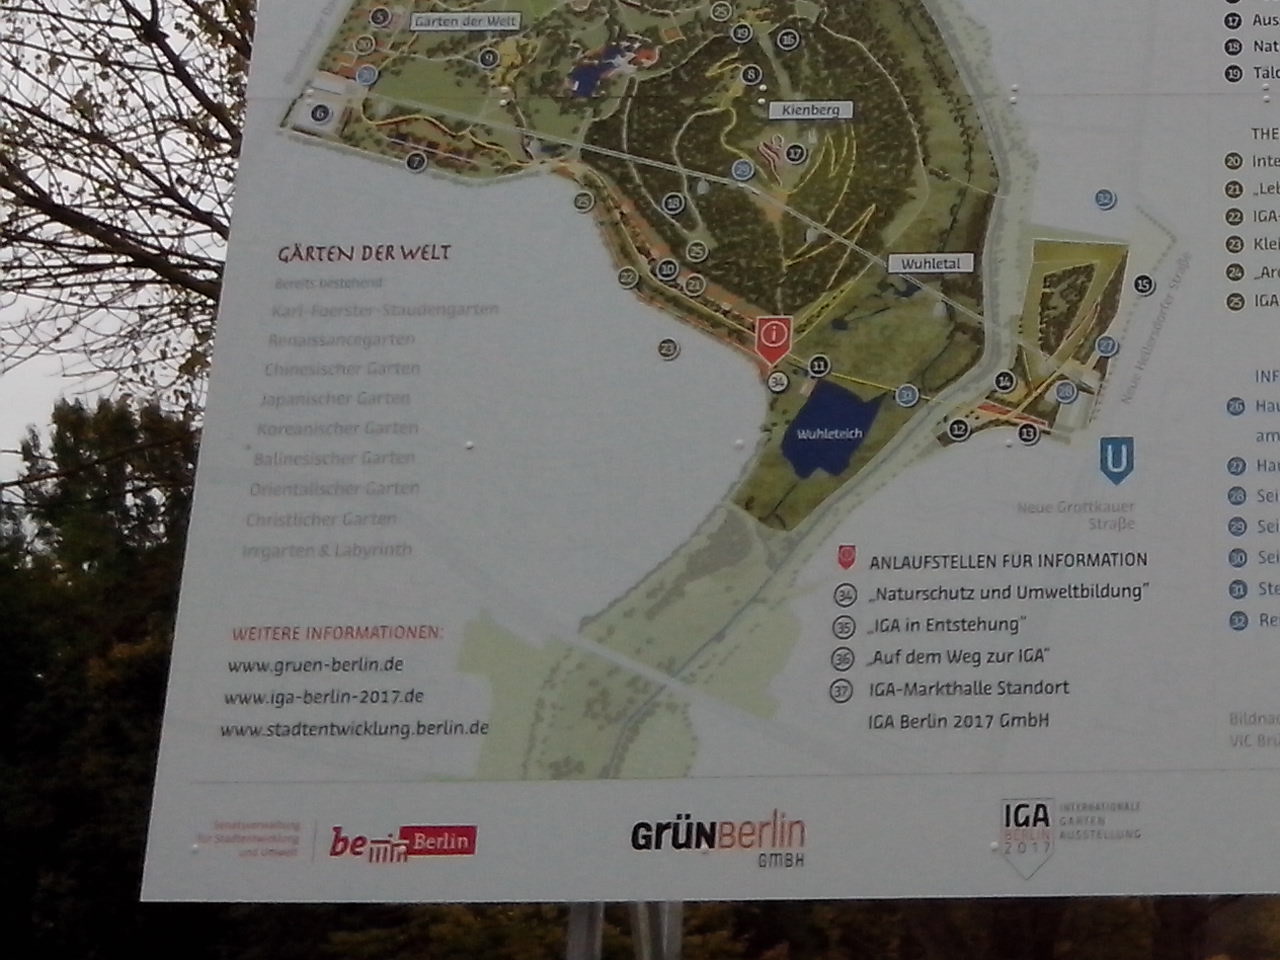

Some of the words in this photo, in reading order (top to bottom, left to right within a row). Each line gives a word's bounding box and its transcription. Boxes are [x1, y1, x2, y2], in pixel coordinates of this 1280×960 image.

[781, 103, 842, 119] Kienberg
[277, 242, 355, 264] GÄRTEN
[361, 244, 396, 262] DER
[399, 243, 452, 262] WELT
[900, 256, 961, 270] Wuhletal
[796, 427, 863, 441] Wuhleteich
[1255, 431, 1280, 443] am
[1106, 444, 1129, 473] U
[868, 553, 997, 571] ANLAUFSTELLEN
[1037, 551, 1148, 569] INFORMATION
[979, 584, 1012, 600] und
[232, 625, 301, 642] WEITERE
[905, 617, 921, 633] in
[227, 655, 404, 677] www.gruen-berlin.de
[905, 648, 942, 665] dem
[946, 649, 982, 669] Weg
[986, 651, 1015, 664] zur
[869, 679, 993, 698] IGA-Markthalle
[996, 679, 1071, 696] Standort
[224, 687, 425, 710] www.iga-berlin-2017.de
[868, 714, 895, 730] IGA
[899, 712, 948, 730] Berlin
[953, 714, 995, 730] 2017
[999, 711, 1050, 729] GmbH
[1004, 802, 1051, 828] IGA
[412, 831, 470, 851] Berlin
